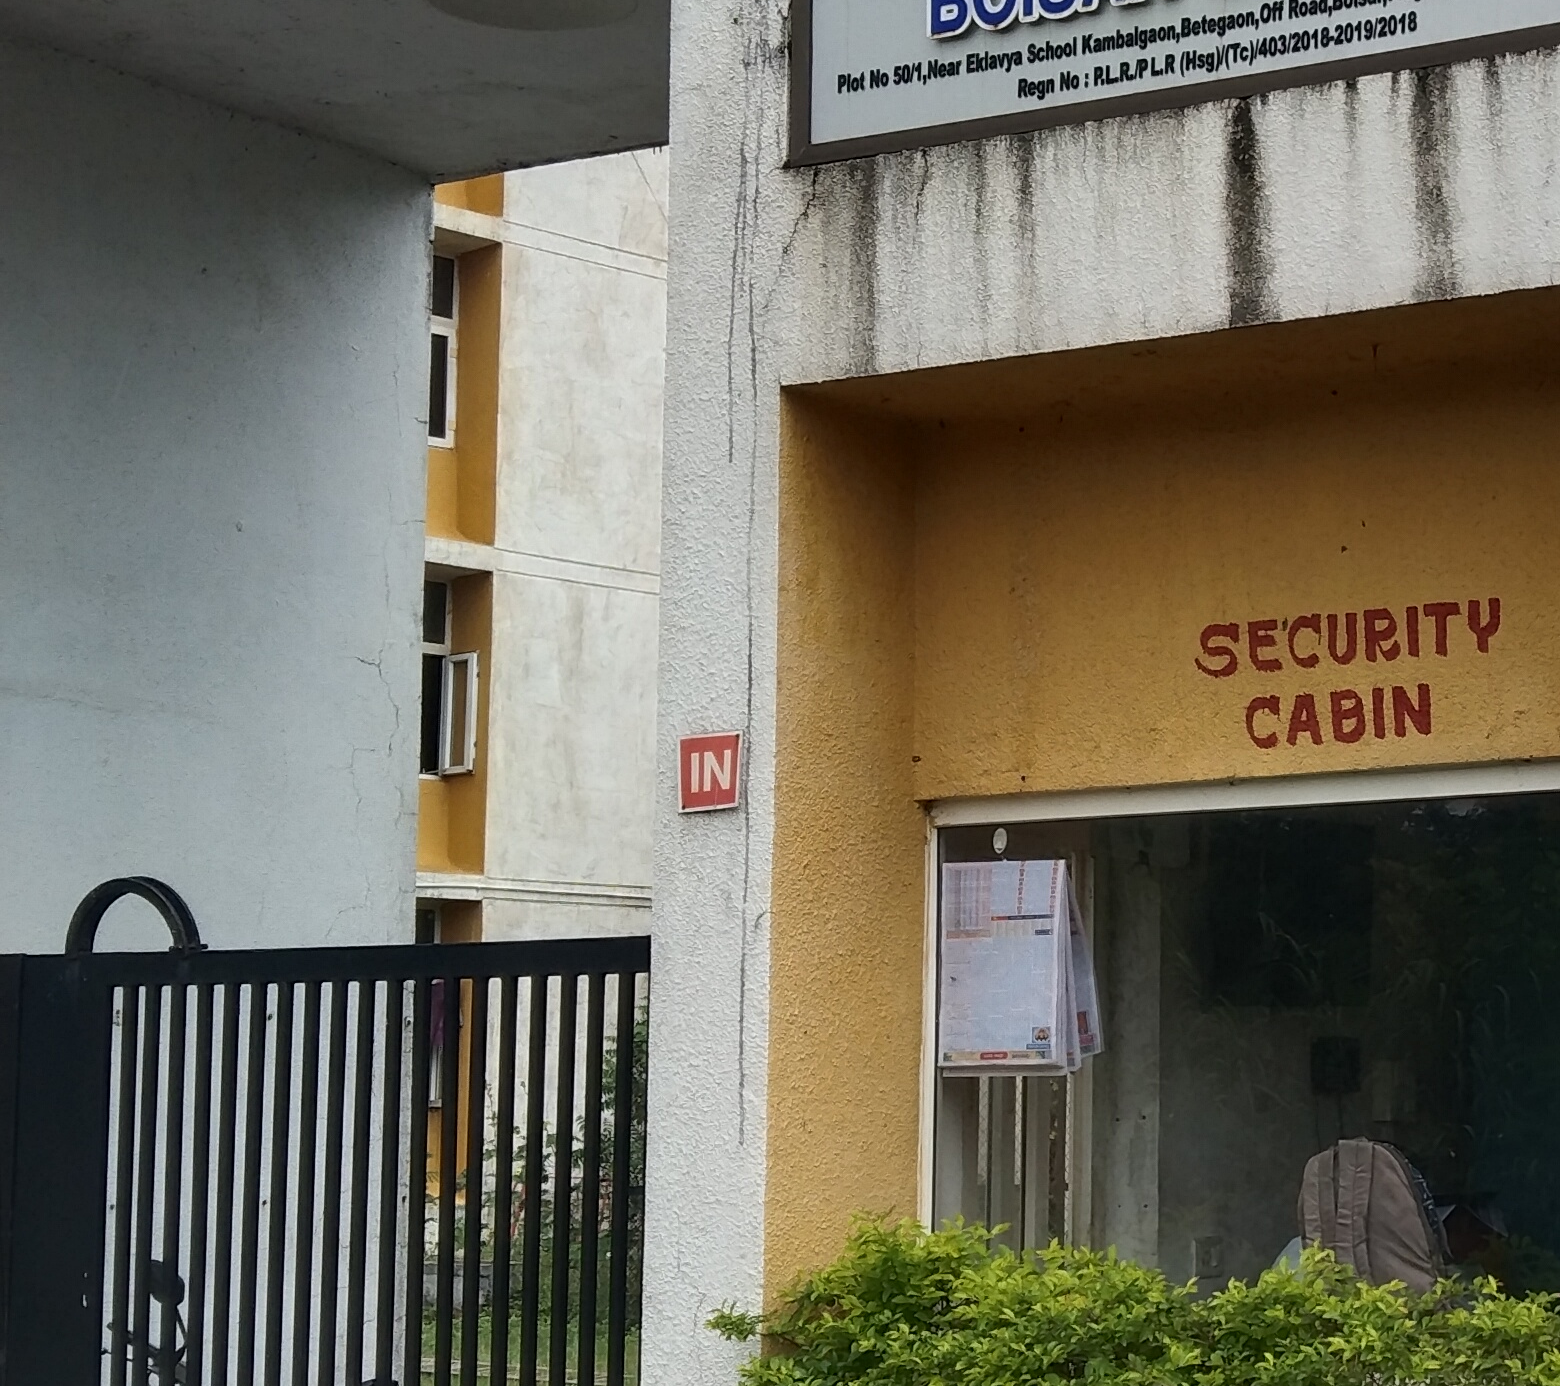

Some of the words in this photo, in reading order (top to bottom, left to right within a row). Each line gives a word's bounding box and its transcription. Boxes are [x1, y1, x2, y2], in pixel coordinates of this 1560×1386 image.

[837, 71, 866, 94] Plot
[869, 68, 890, 88] No
[966, 50, 1023, 74] Eklavya
[1026, 36, 1077, 63] School
[1017, 77, 1055, 100] Regn
[1059, 71, 1080, 91] No
[1195, 597, 1501, 678] SECURITY
[1245, 683, 1433, 749] CABIN
[690, 749, 732, 793] IN
